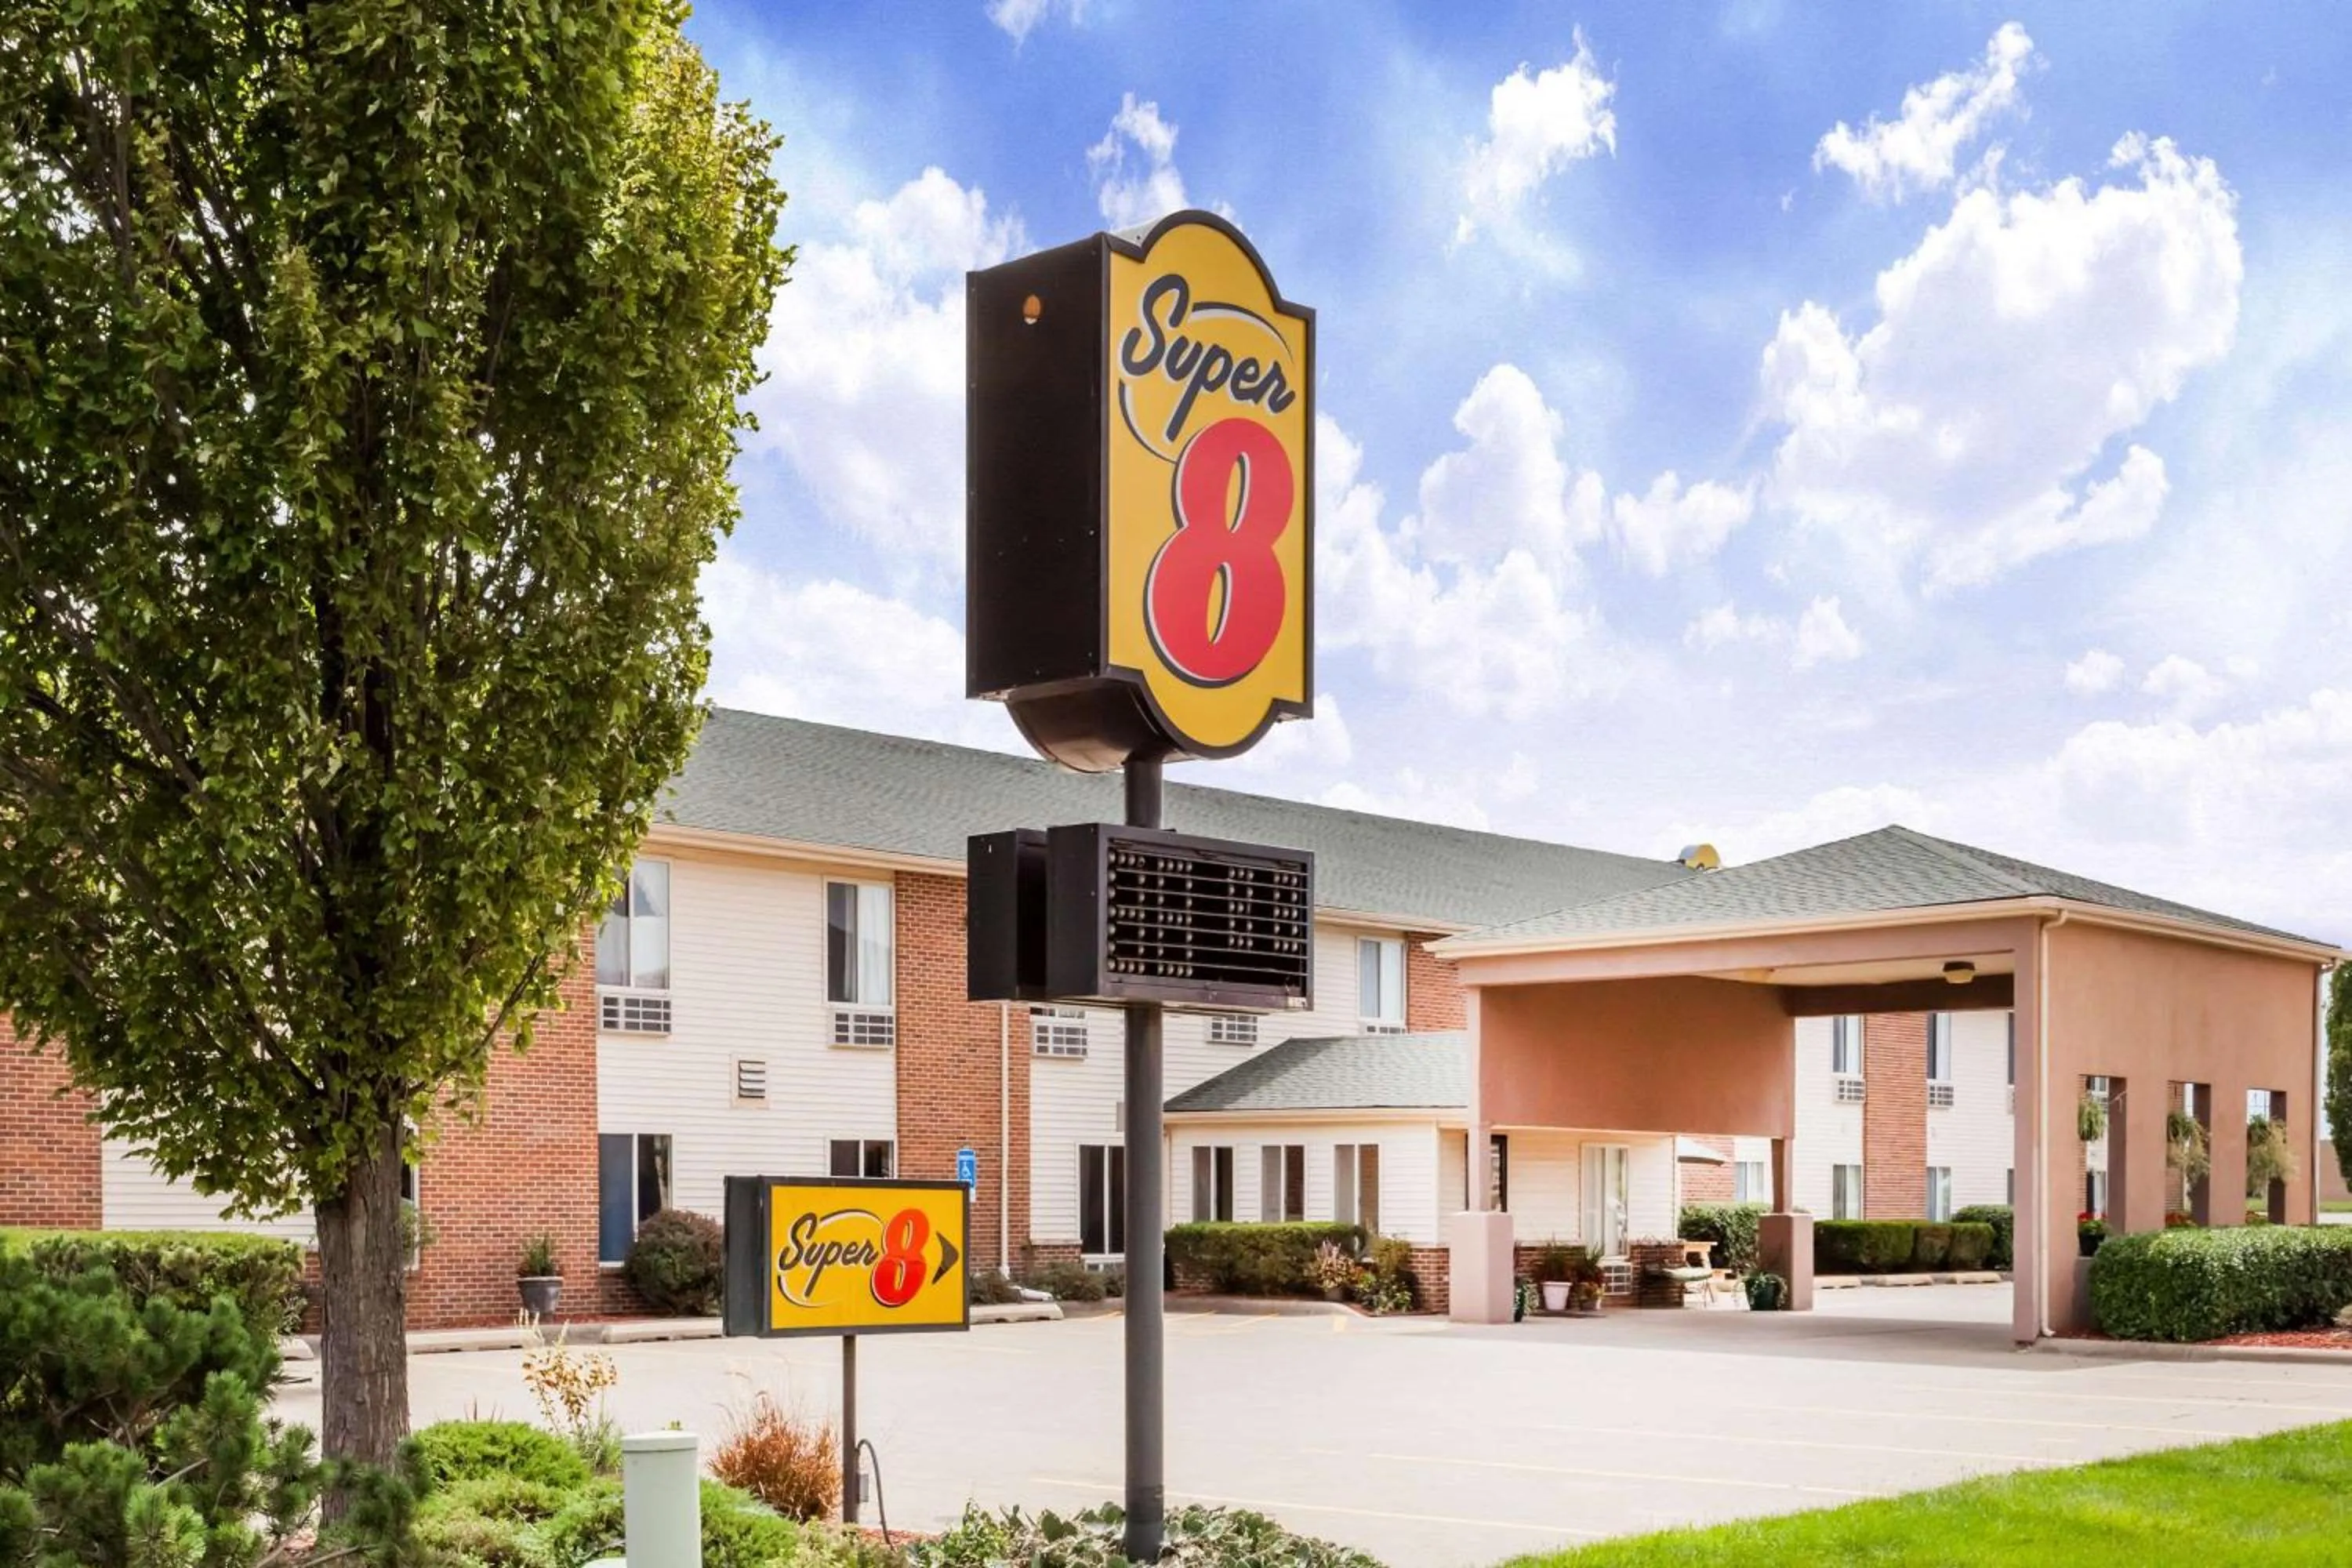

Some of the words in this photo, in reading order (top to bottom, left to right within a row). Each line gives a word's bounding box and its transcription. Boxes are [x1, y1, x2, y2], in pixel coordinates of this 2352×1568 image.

[1120, 273, 1297, 444] Super
[1143, 416, 1295, 688] 8
[778, 1211, 880, 1298] Super
[869, 1208, 930, 1308] 8
